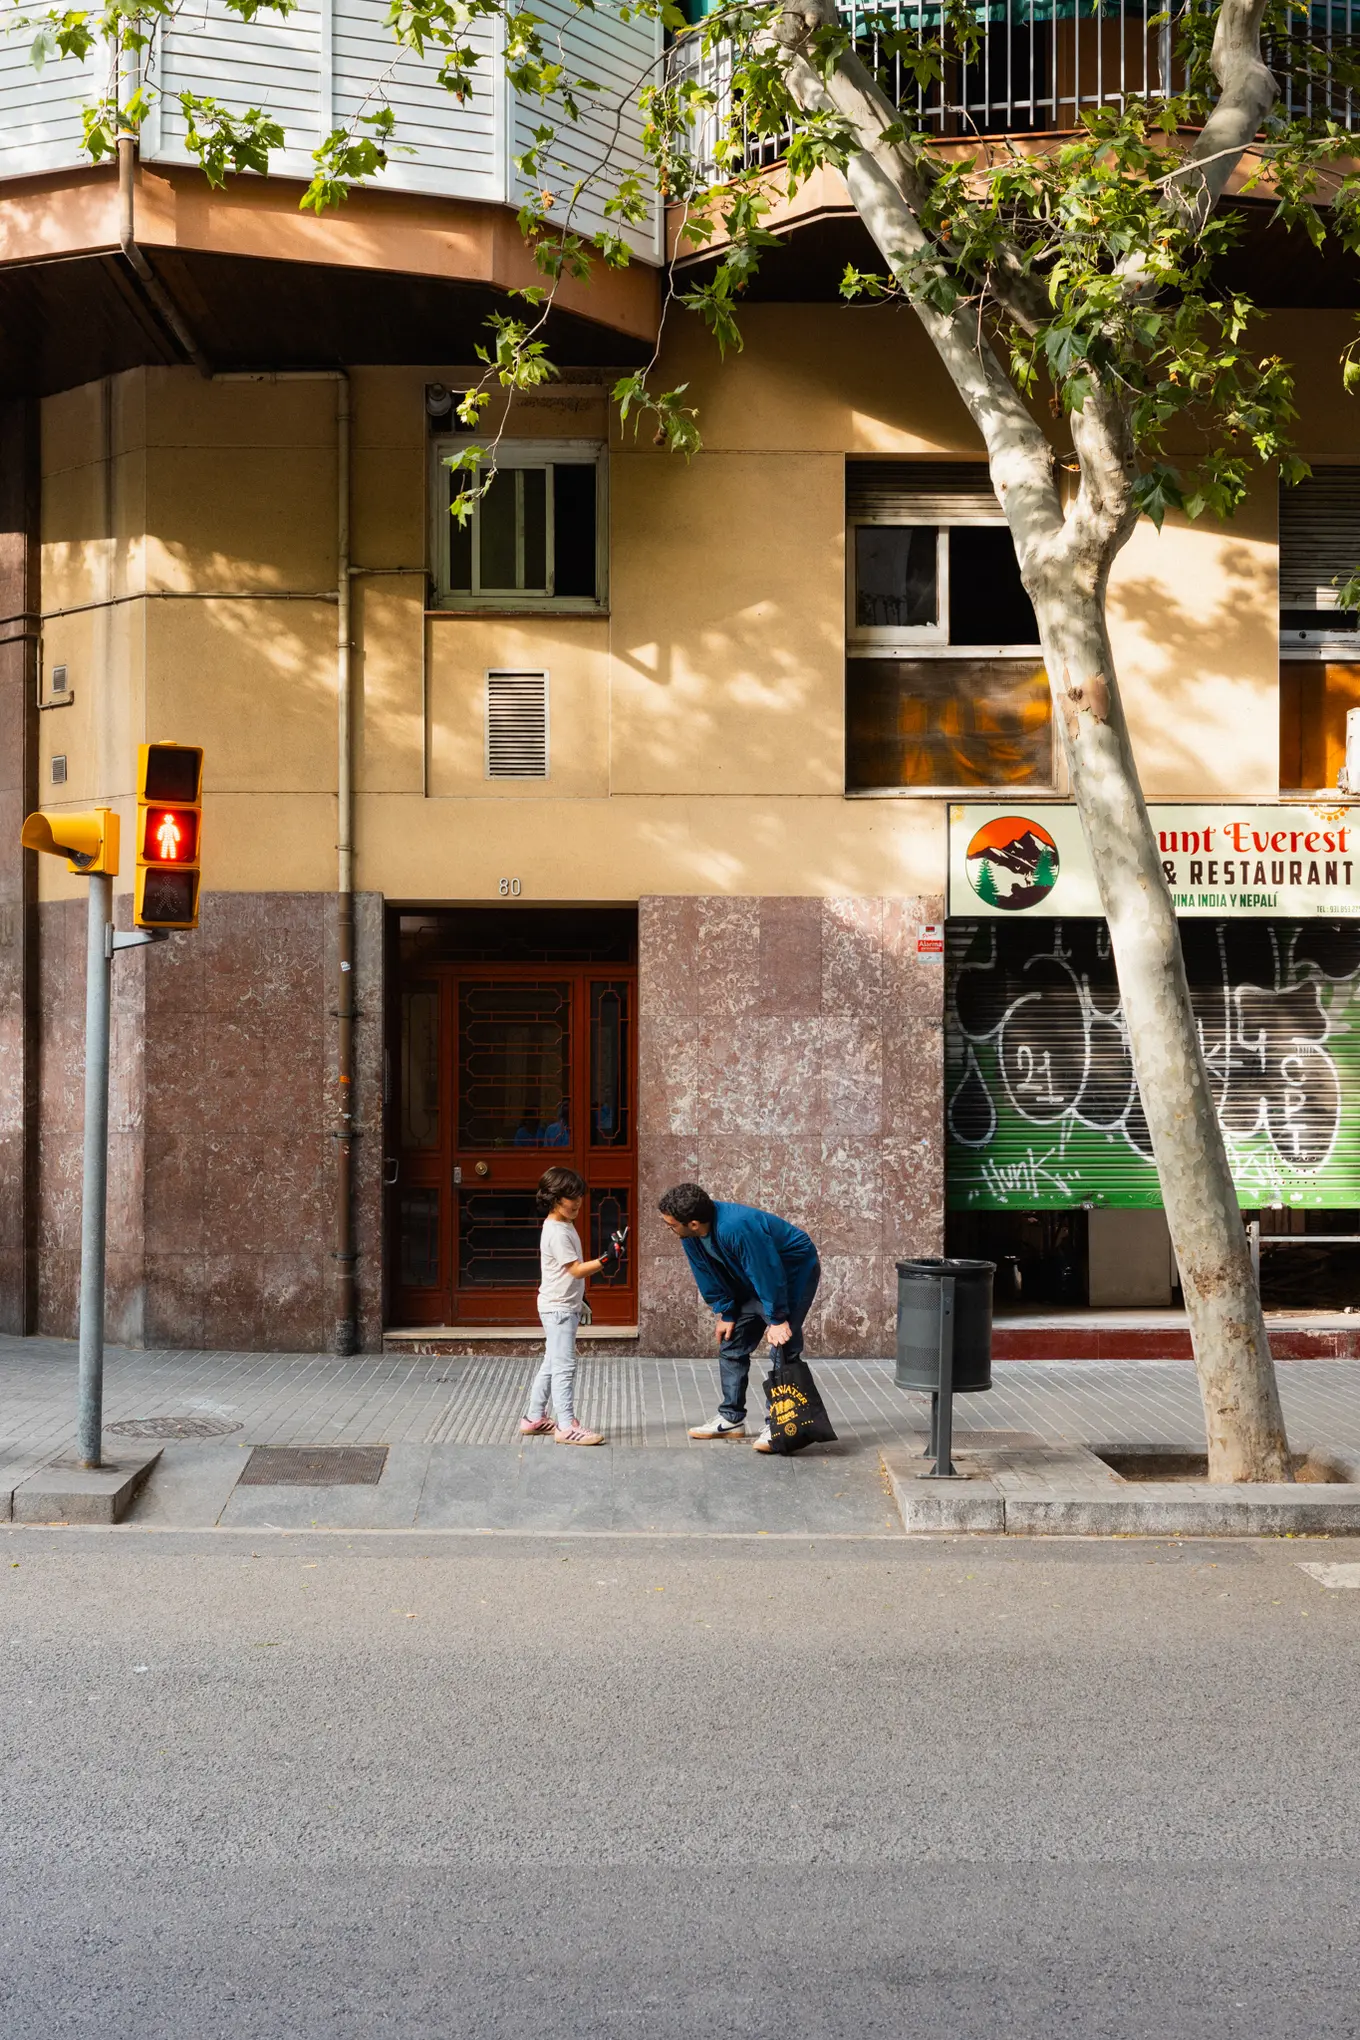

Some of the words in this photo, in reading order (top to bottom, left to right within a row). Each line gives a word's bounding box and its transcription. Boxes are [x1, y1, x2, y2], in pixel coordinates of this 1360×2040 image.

[1158, 826, 1217, 856] unt
[1223, 822, 1352, 853] Everest
[1162, 860, 1177, 885] &
[1190, 860, 1354, 885] RESTAURANT
[499, 877, 521, 896] 80
[1198, 893, 1227, 907] INDIA
[1229, 893, 1238, 907] Y
[1240, 891, 1279, 907] NEPALÍ
[918, 940, 943, 948] Alarma
[770, 1384, 808, 1405] KWATER
